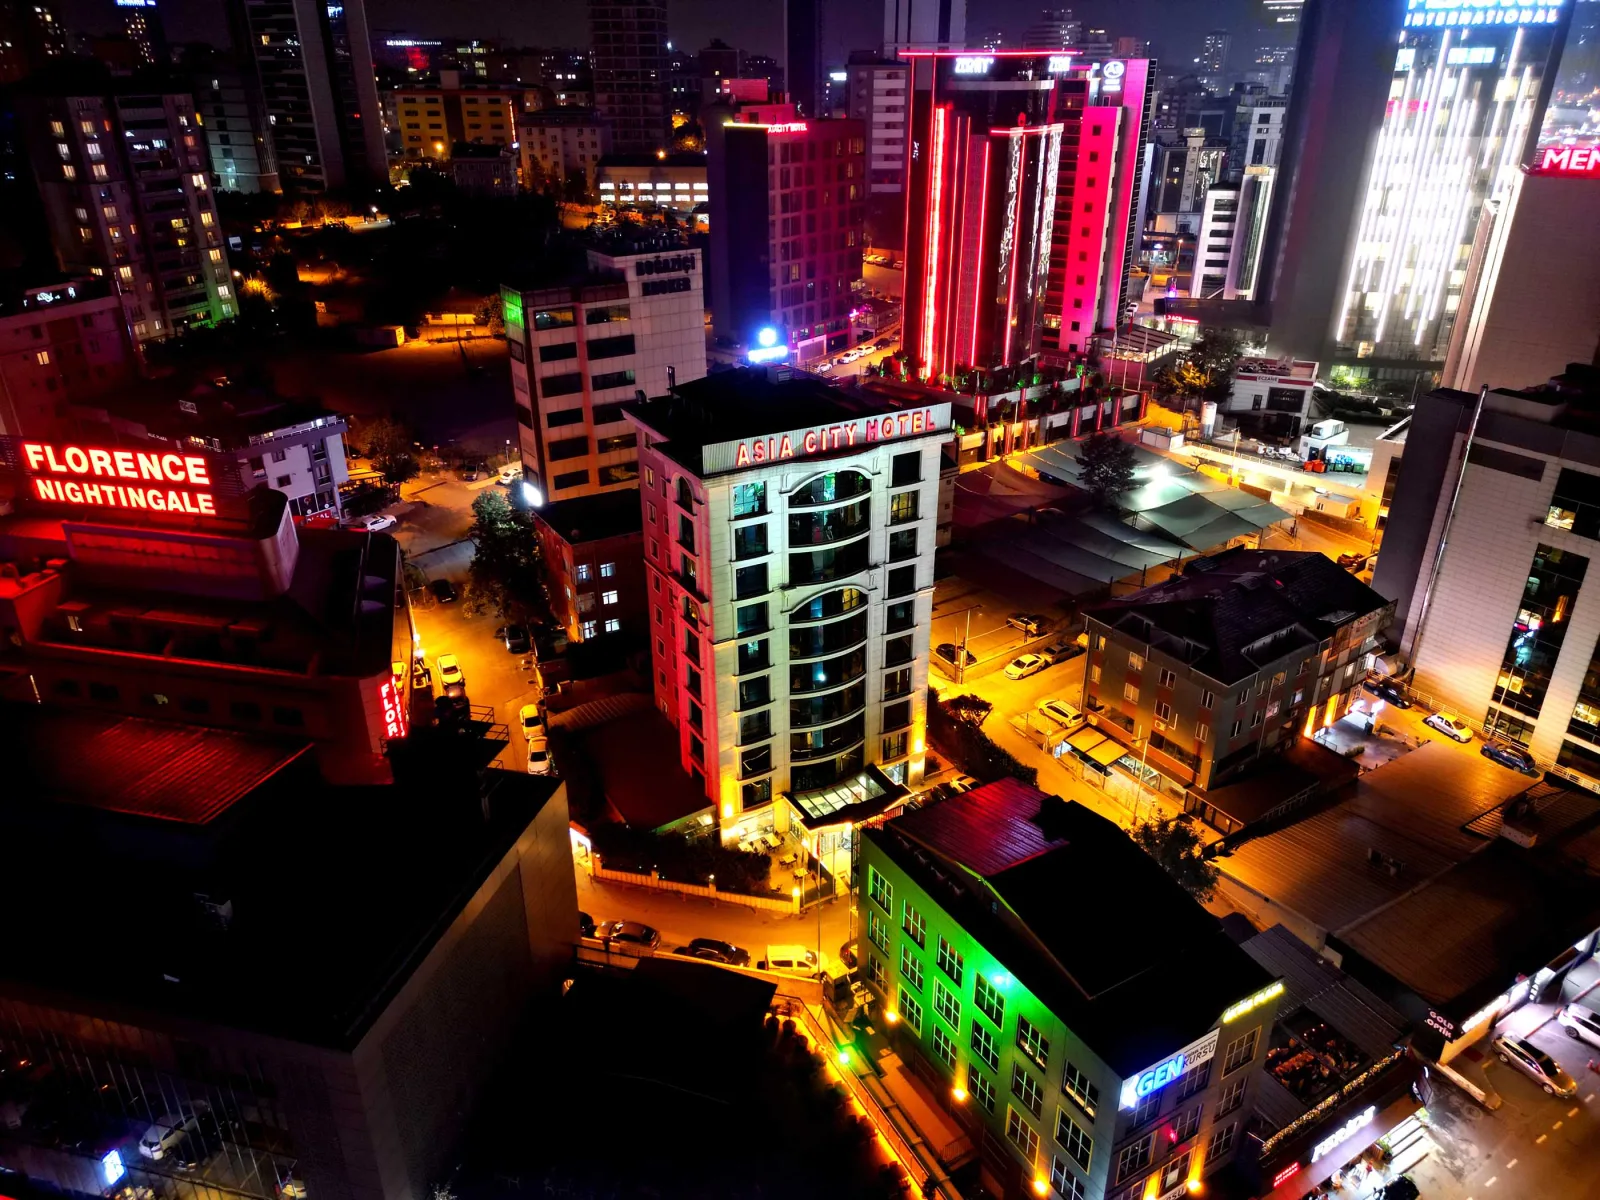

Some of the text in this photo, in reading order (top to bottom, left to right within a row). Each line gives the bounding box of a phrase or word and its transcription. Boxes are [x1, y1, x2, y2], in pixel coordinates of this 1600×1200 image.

[1404, 9, 1558, 26] INTERNATIONAL
[736, 411, 935, 466] ASIA CITY HOTEL
[24, 443, 210, 485] FLORENCE
[35, 478, 216, 515] NIGHTINGALE
[1426, 1018, 1451, 1038] OPTİK
[1430, 1011, 1454, 1030] GOLD
[1182, 1043, 1216, 1067] KURSU
[1136, 1055, 1184, 1097] GEN
